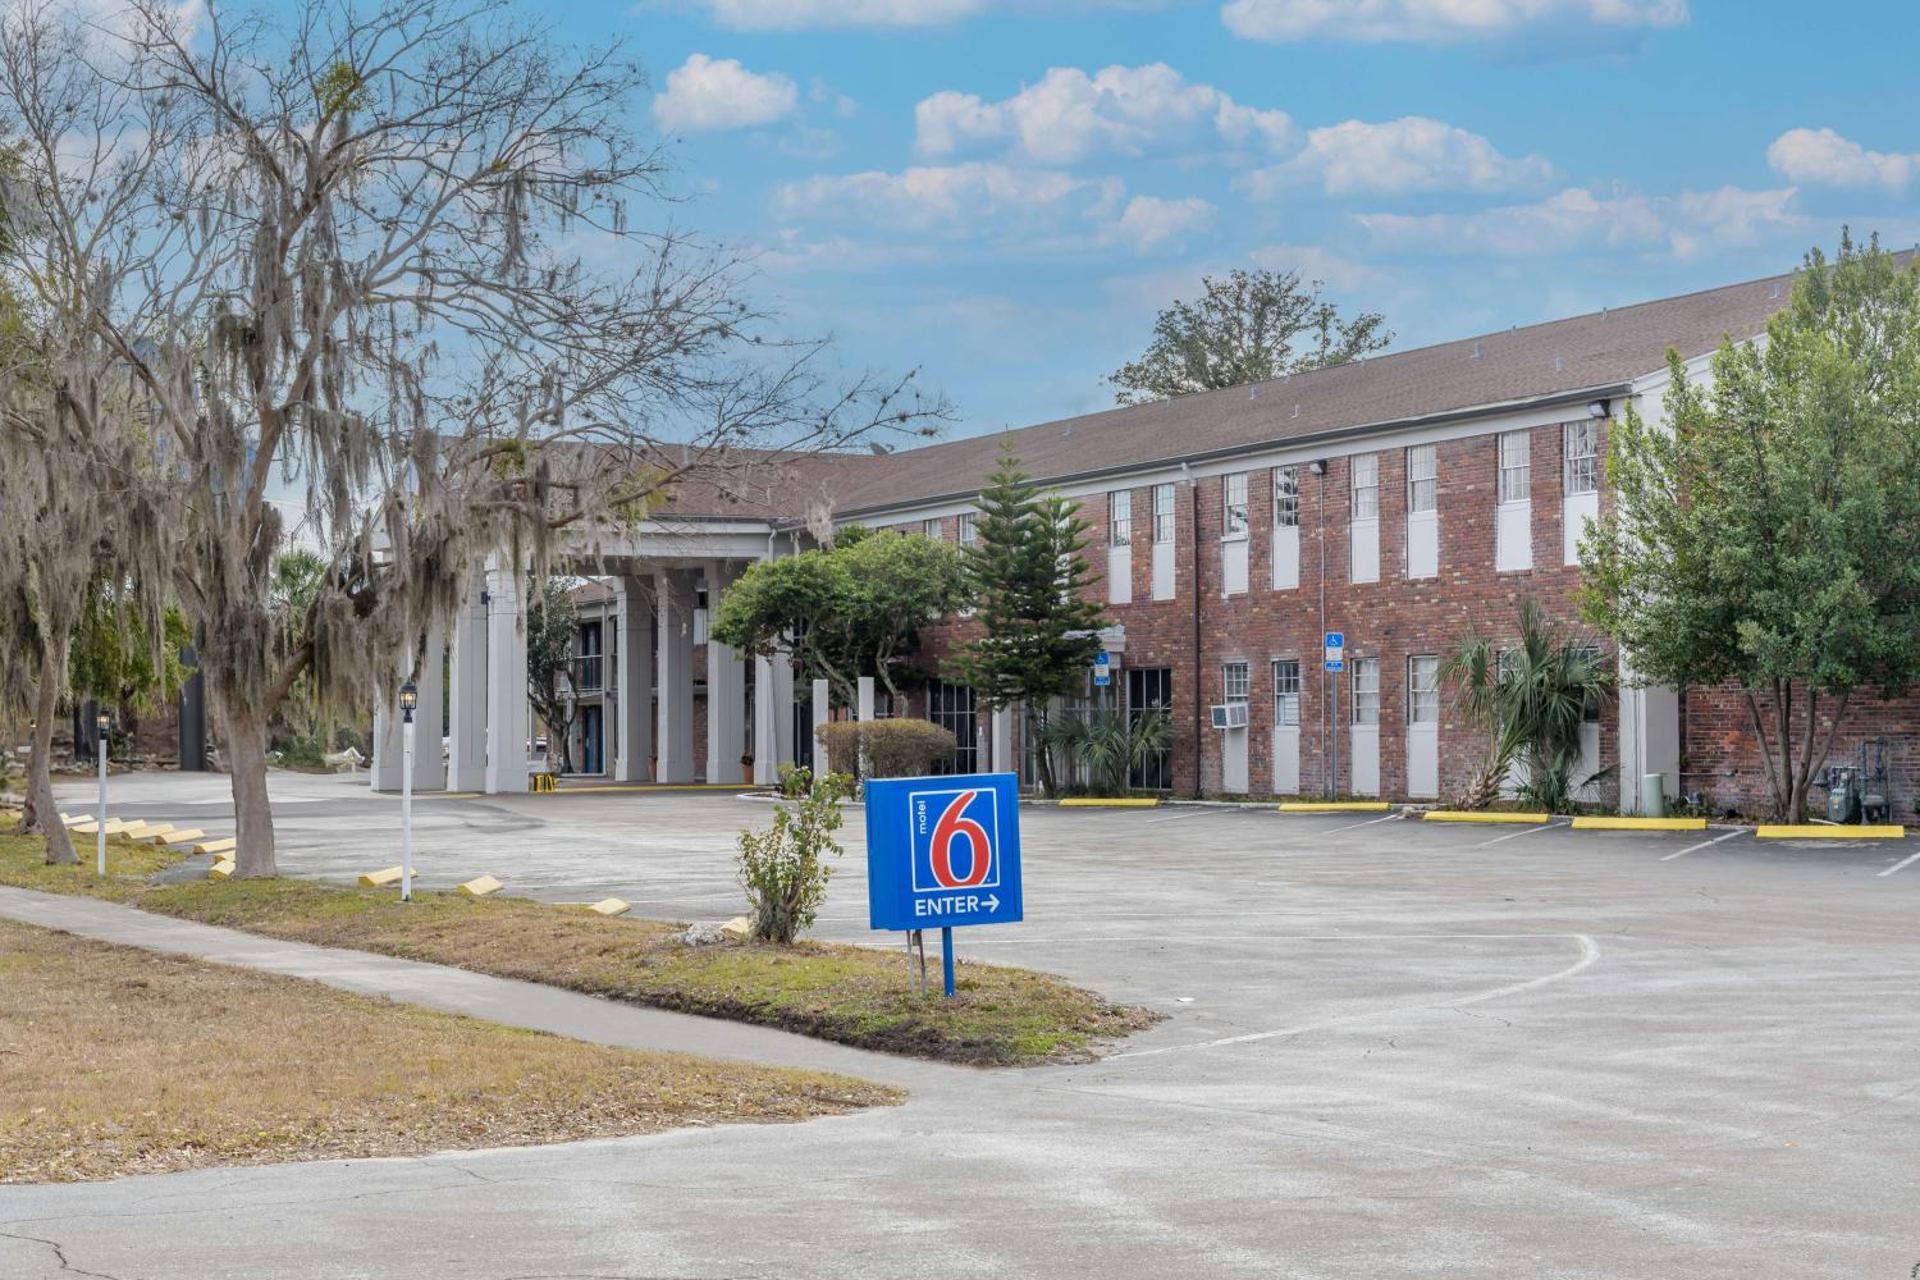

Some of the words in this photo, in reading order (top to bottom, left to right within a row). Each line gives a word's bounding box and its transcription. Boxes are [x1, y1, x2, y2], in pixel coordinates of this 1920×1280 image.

[917, 800, 927, 834] motel
[930, 790, 991, 888] 6
[915, 896, 979, 916] ENTER
